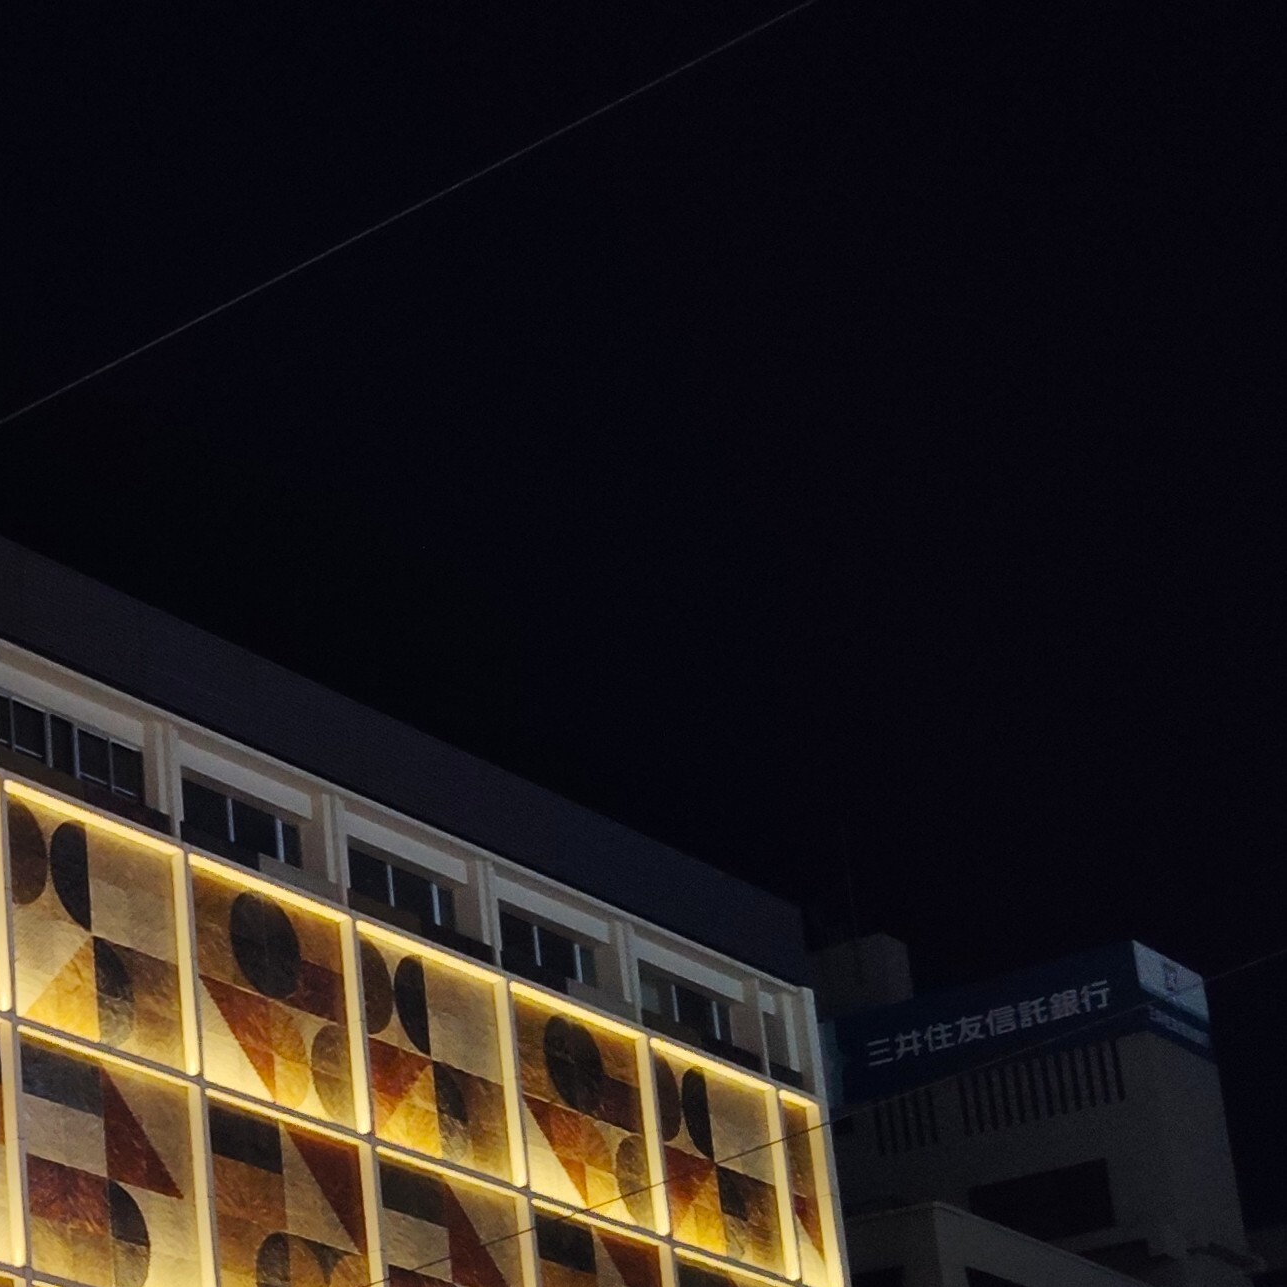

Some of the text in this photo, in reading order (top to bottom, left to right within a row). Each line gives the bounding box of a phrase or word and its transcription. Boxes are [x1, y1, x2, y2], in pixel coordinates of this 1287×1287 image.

[867, 979, 1112, 1068] 三井住友信託銀行
